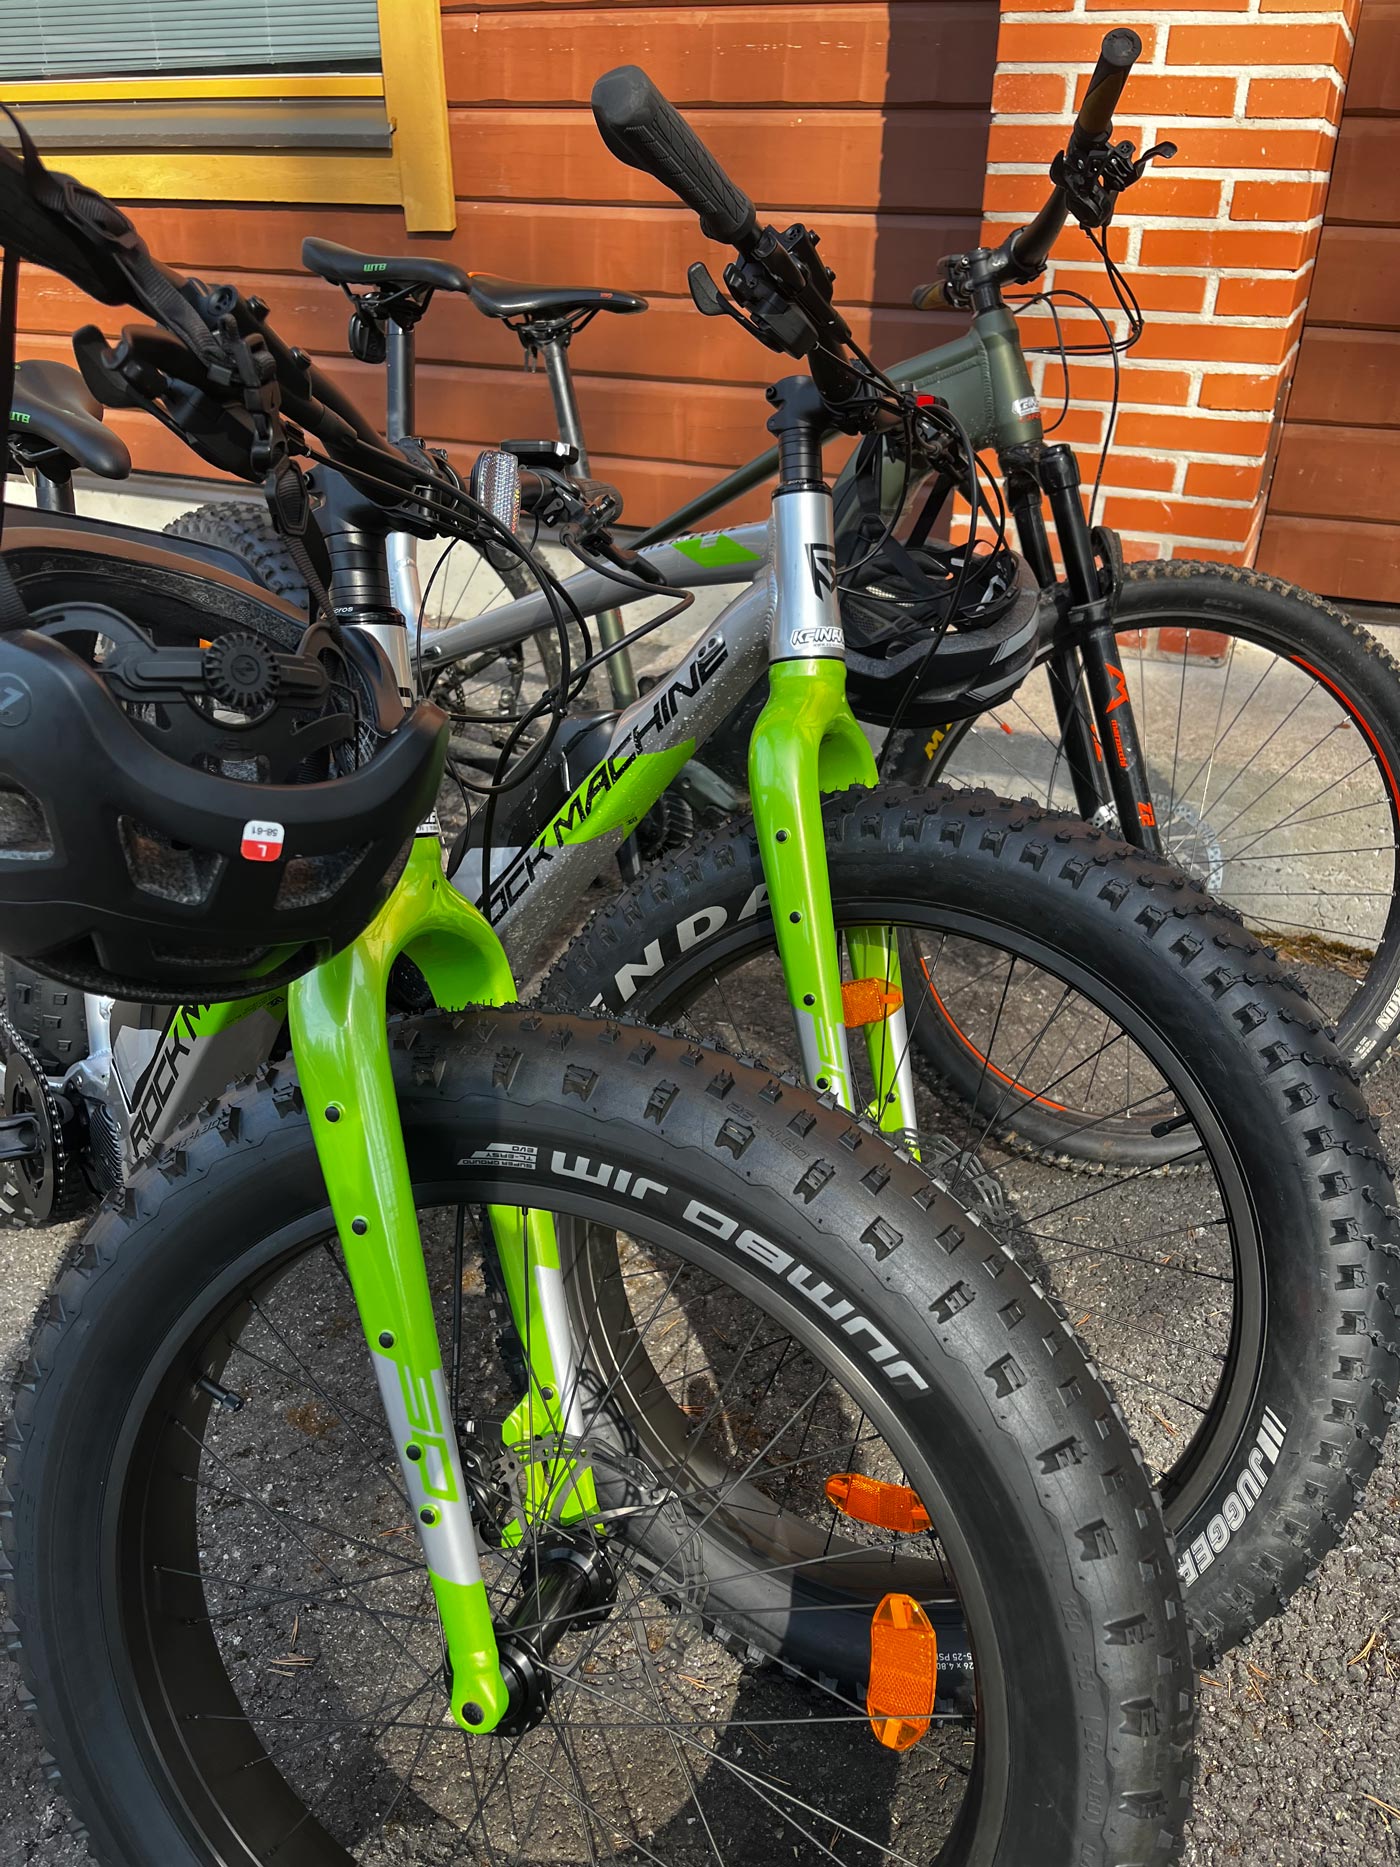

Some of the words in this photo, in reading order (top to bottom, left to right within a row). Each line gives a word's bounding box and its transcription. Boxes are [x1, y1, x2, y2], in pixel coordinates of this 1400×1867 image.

[363, 262, 388, 272] WTB
[553, 640, 729, 850] MACHINE
[251, 826, 279, 837] 58-61
[257, 844, 268, 858] L
[129, 1021, 191, 1162] ROCK
[550, 1150, 669, 1200] JIM
[682, 1199, 929, 1391] JUMBO
